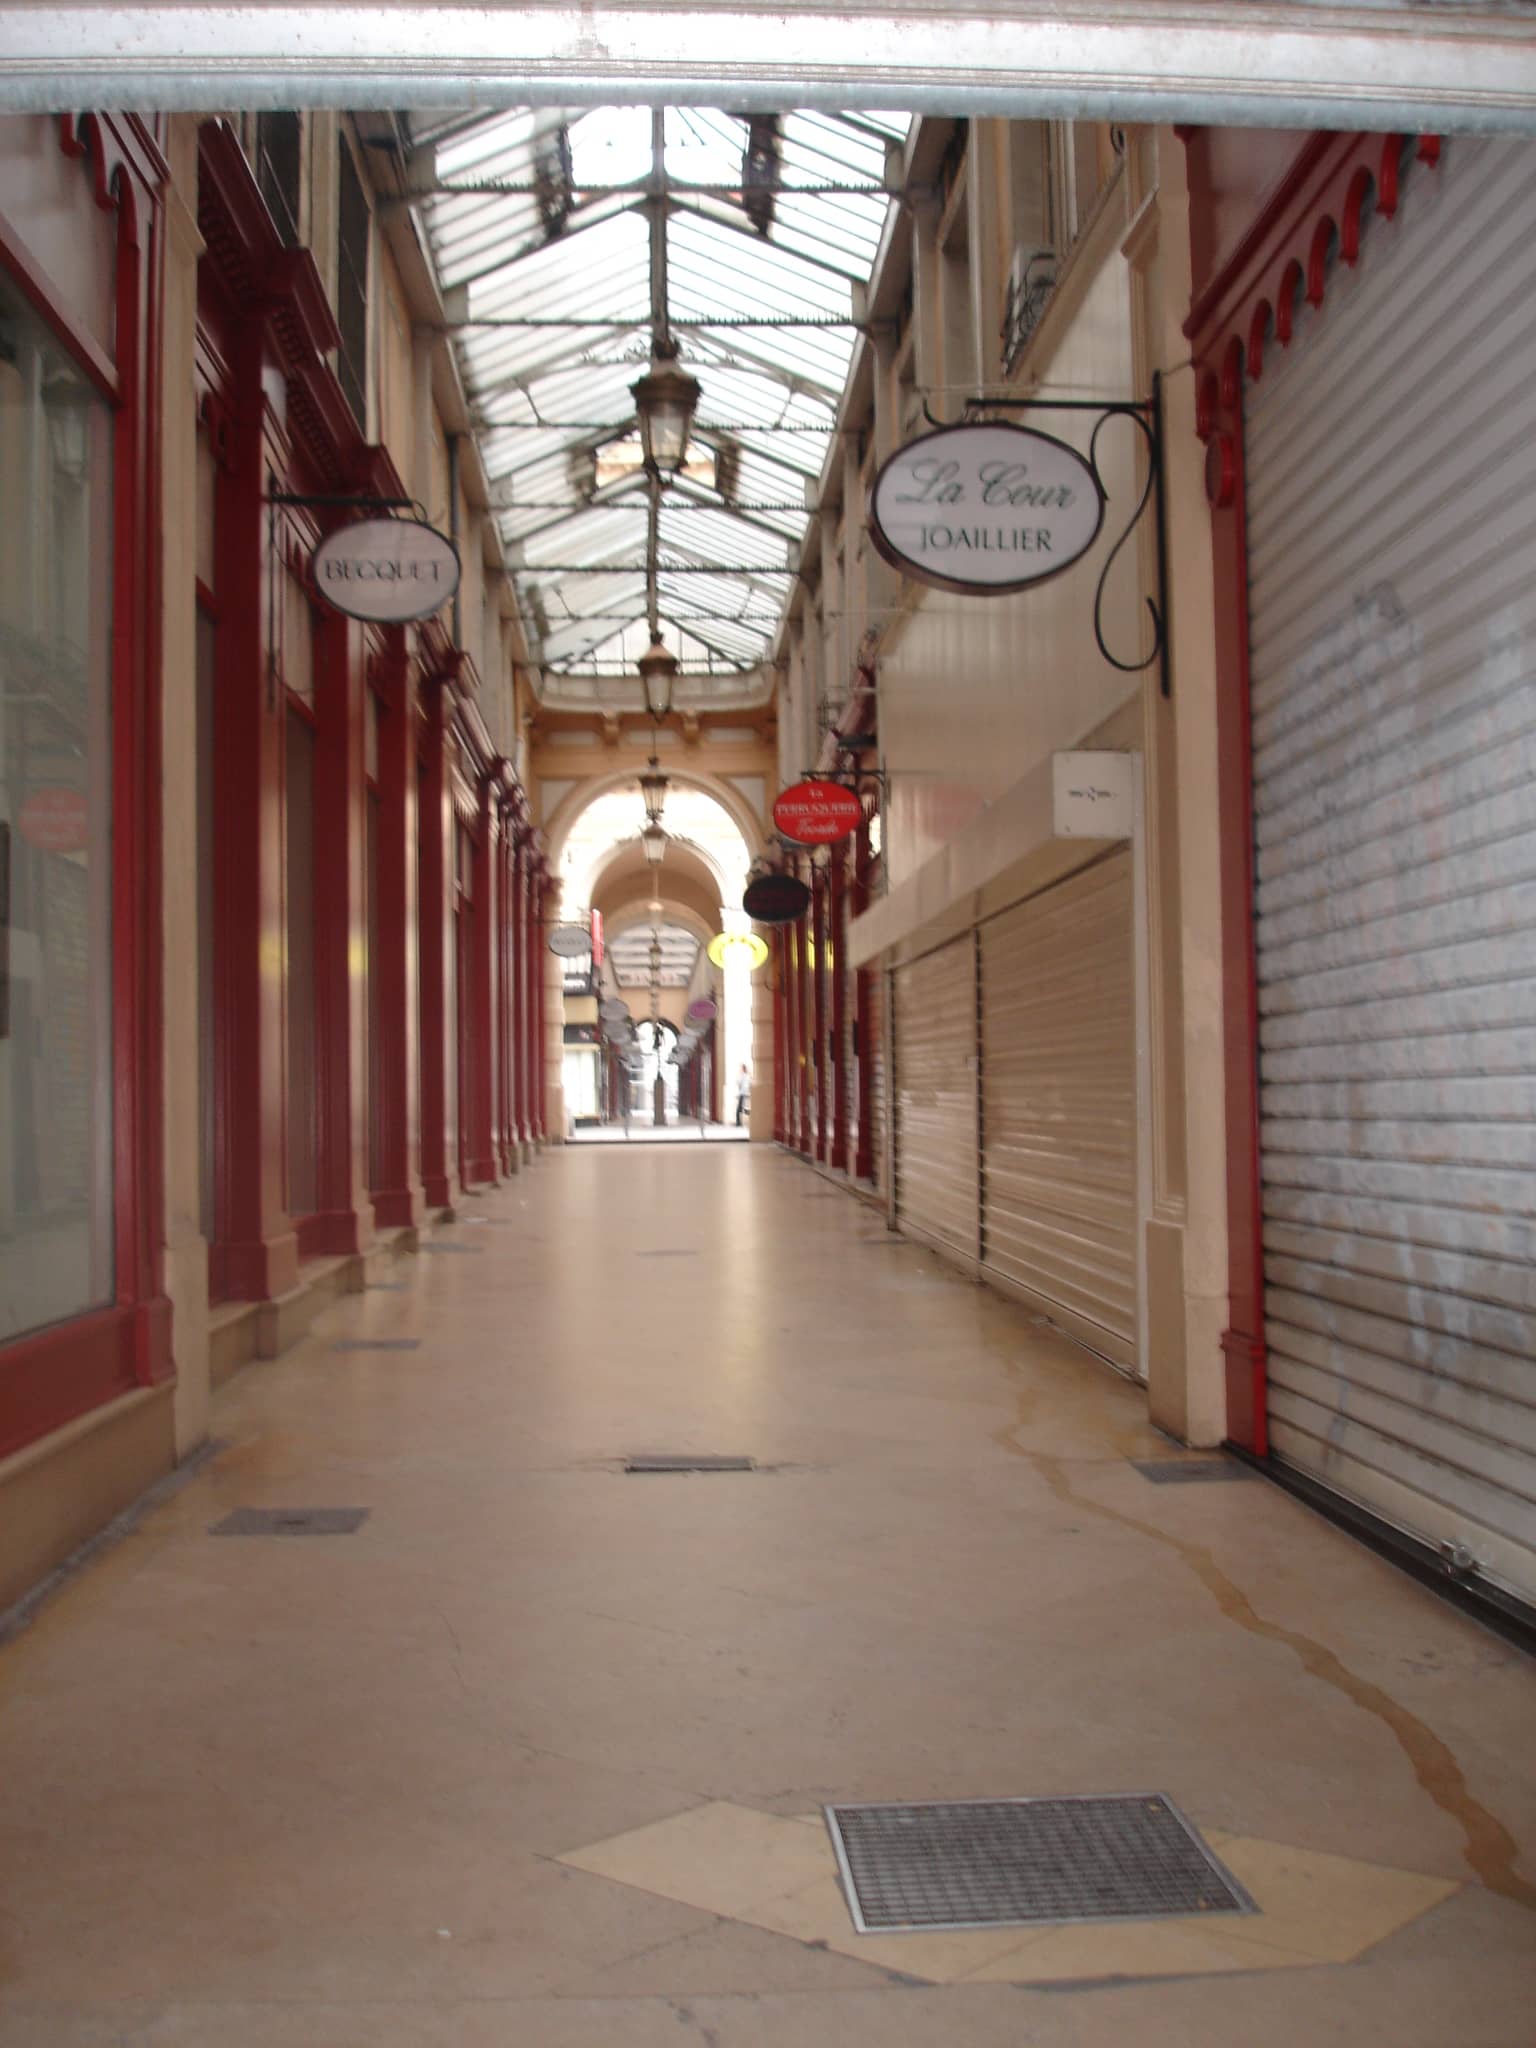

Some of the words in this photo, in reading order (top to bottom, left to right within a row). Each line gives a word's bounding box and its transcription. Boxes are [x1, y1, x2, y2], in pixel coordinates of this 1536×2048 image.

[895, 457, 964, 505] La
[977, 459, 1074, 508] Cour
[920, 525, 1052, 552] JOAILLIER
[325, 560, 441, 583] BECQUET
